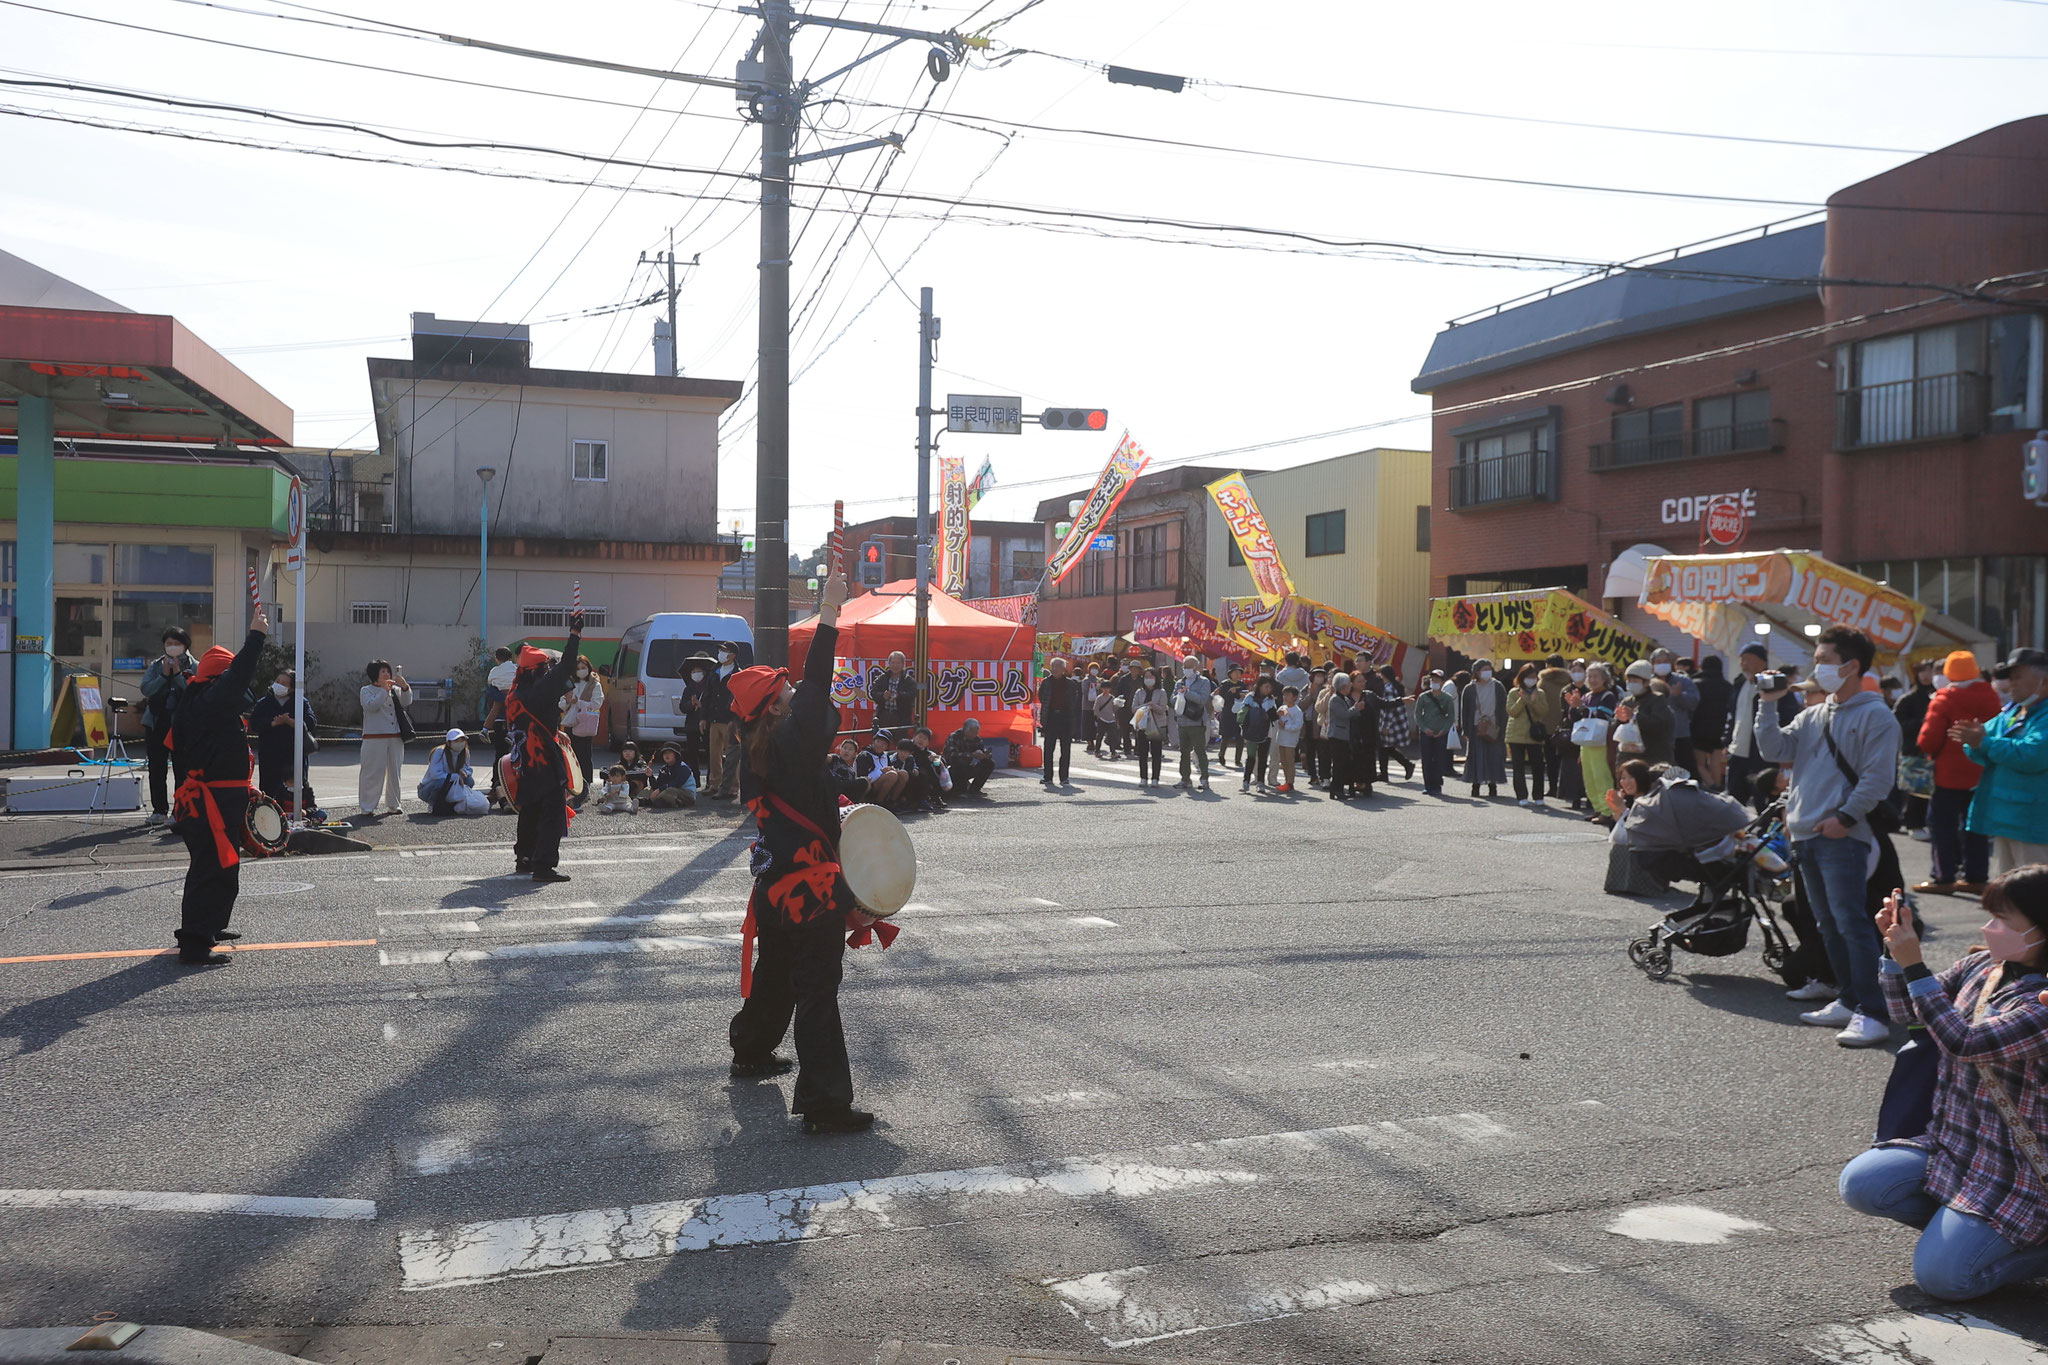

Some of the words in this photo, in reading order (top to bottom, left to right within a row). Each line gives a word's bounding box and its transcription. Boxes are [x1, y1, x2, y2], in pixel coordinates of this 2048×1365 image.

[951, 405, 1018, 424] 串良町岡崎
[946, 482, 966, 597] 射的ゲーム
[1049, 466, 1123, 577] 射的ゲーム
[1671, 563, 1767, 597] 10円パン
[1801, 570, 1912, 644] 10円パン
[1313, 617, 1377, 647] チョコバナナ
